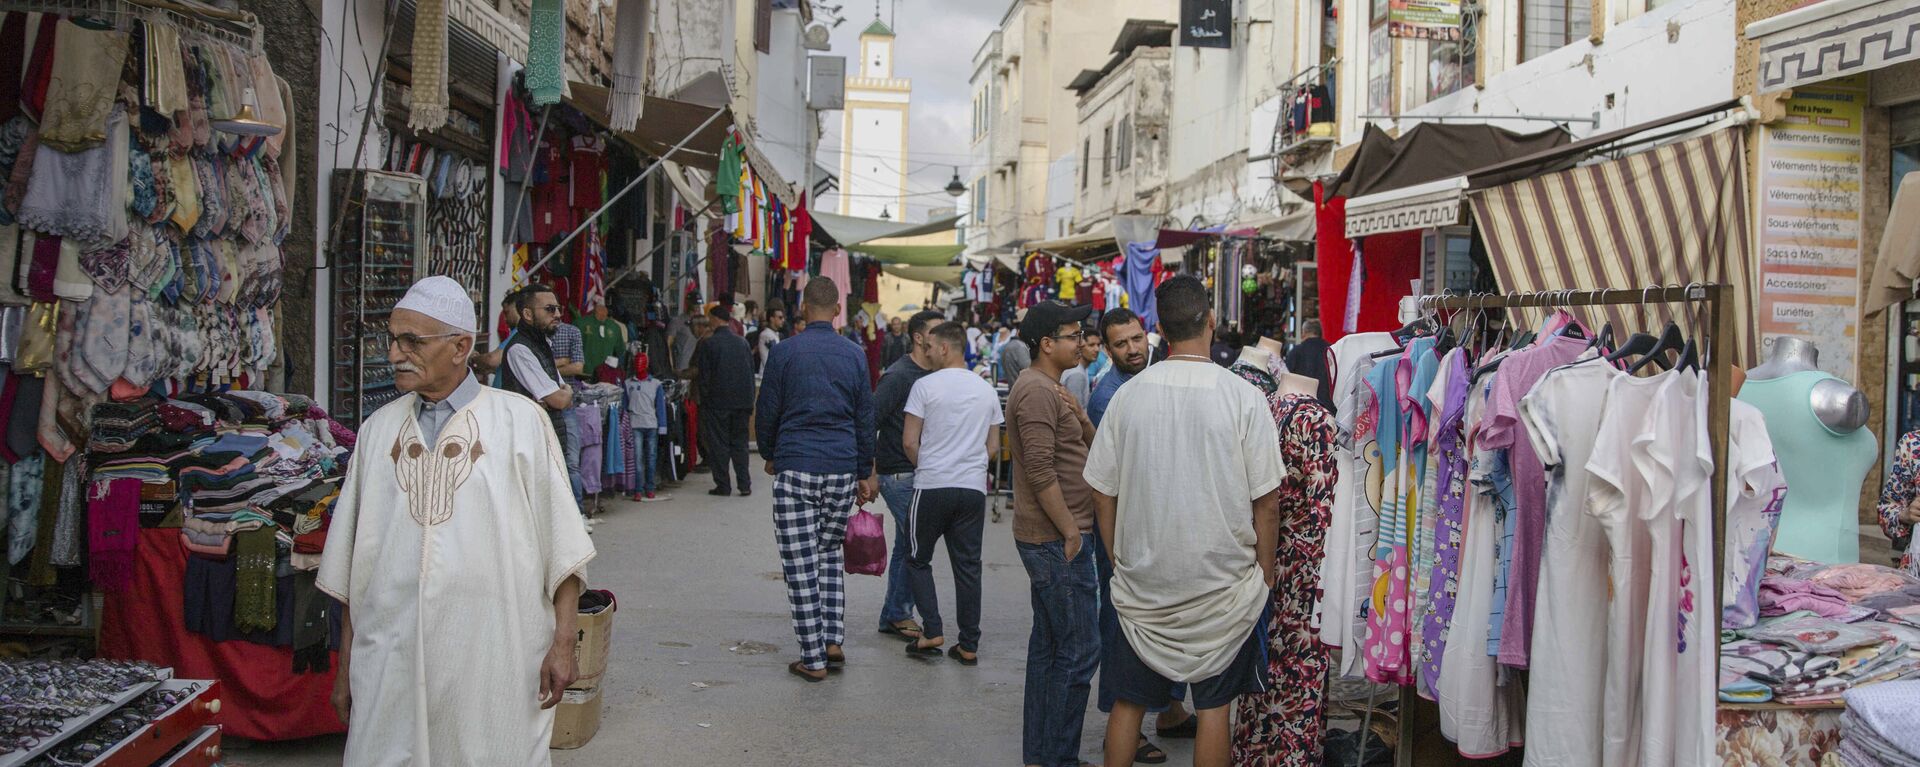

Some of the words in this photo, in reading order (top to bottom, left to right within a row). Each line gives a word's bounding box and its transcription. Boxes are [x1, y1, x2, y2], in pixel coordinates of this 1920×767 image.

[1793, 104, 1807, 113] Prêt
[1813, 105, 1833, 114] Porter
[1771, 130, 1820, 143] Vêtements
[1822, 134, 1861, 146] Femmes
[1770, 160, 1818, 172] Vêtements
[1820, 162, 1858, 175] Hommes
[1769, 189, 1816, 202] Vêtements
[1819, 192, 1850, 204] Enfants
[1767, 218, 1840, 231] Sous-vêtements
[1766, 248, 1788, 258] Sacs
[1800, 250, 1823, 260] Main
[1766, 278, 1826, 290] Accessoires
